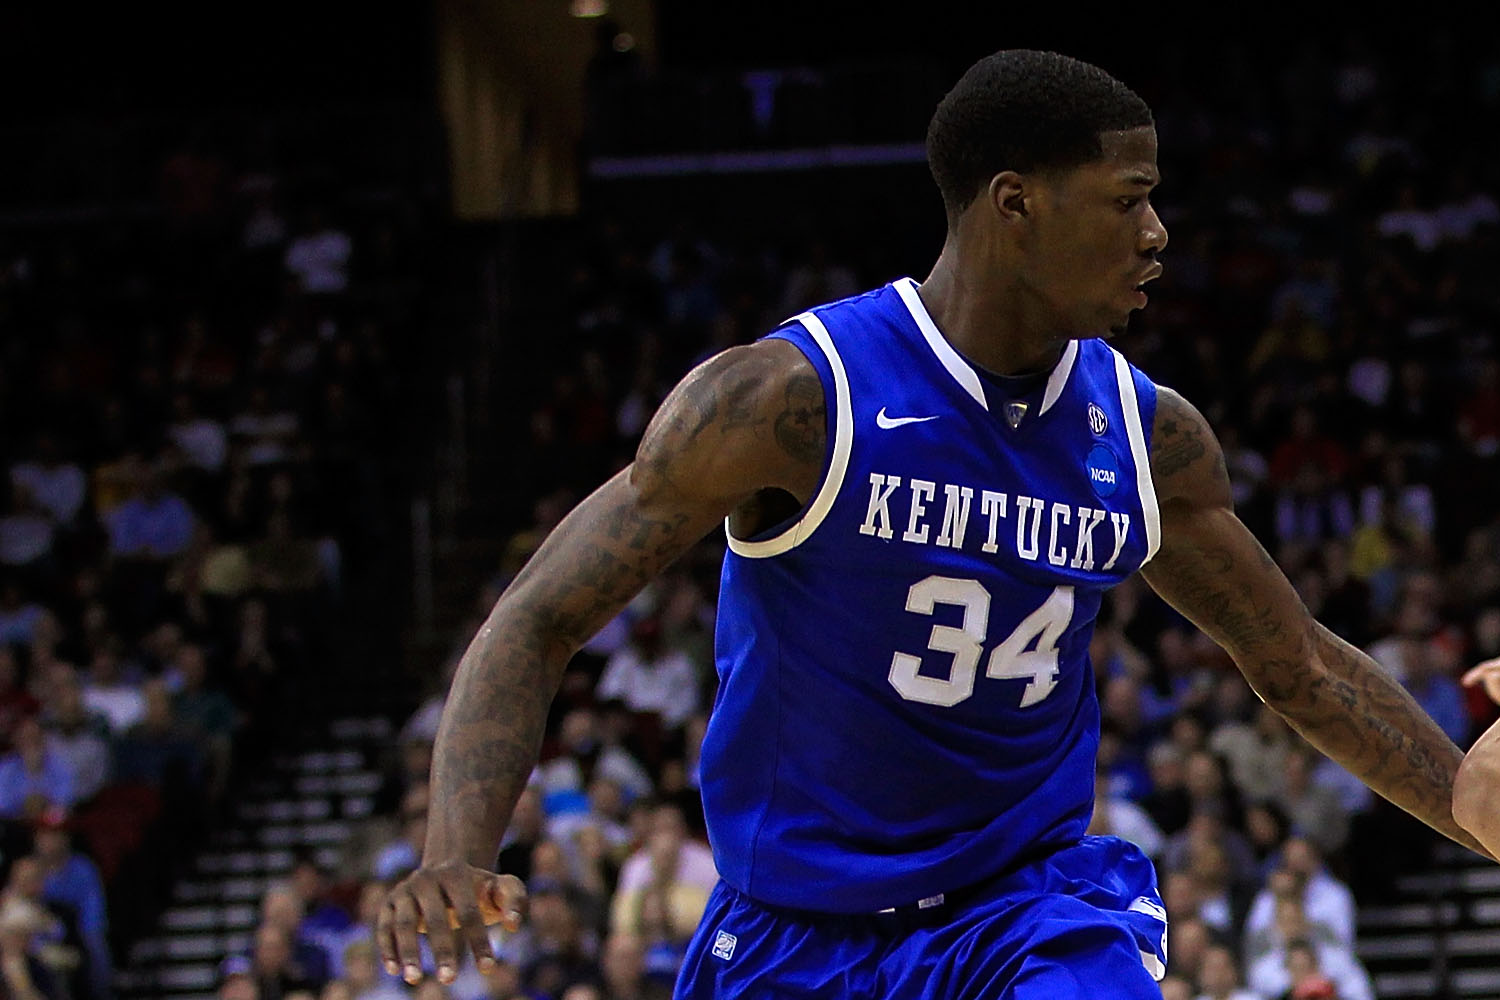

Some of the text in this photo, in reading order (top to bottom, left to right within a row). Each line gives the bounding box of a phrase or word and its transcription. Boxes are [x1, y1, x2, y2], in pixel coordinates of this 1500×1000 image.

[1088, 405, 1105, 433] SEC
[1091, 467, 1115, 484] NCAA
[859, 472, 1129, 571] KENTUCKY
[888, 575, 1075, 708] 34
